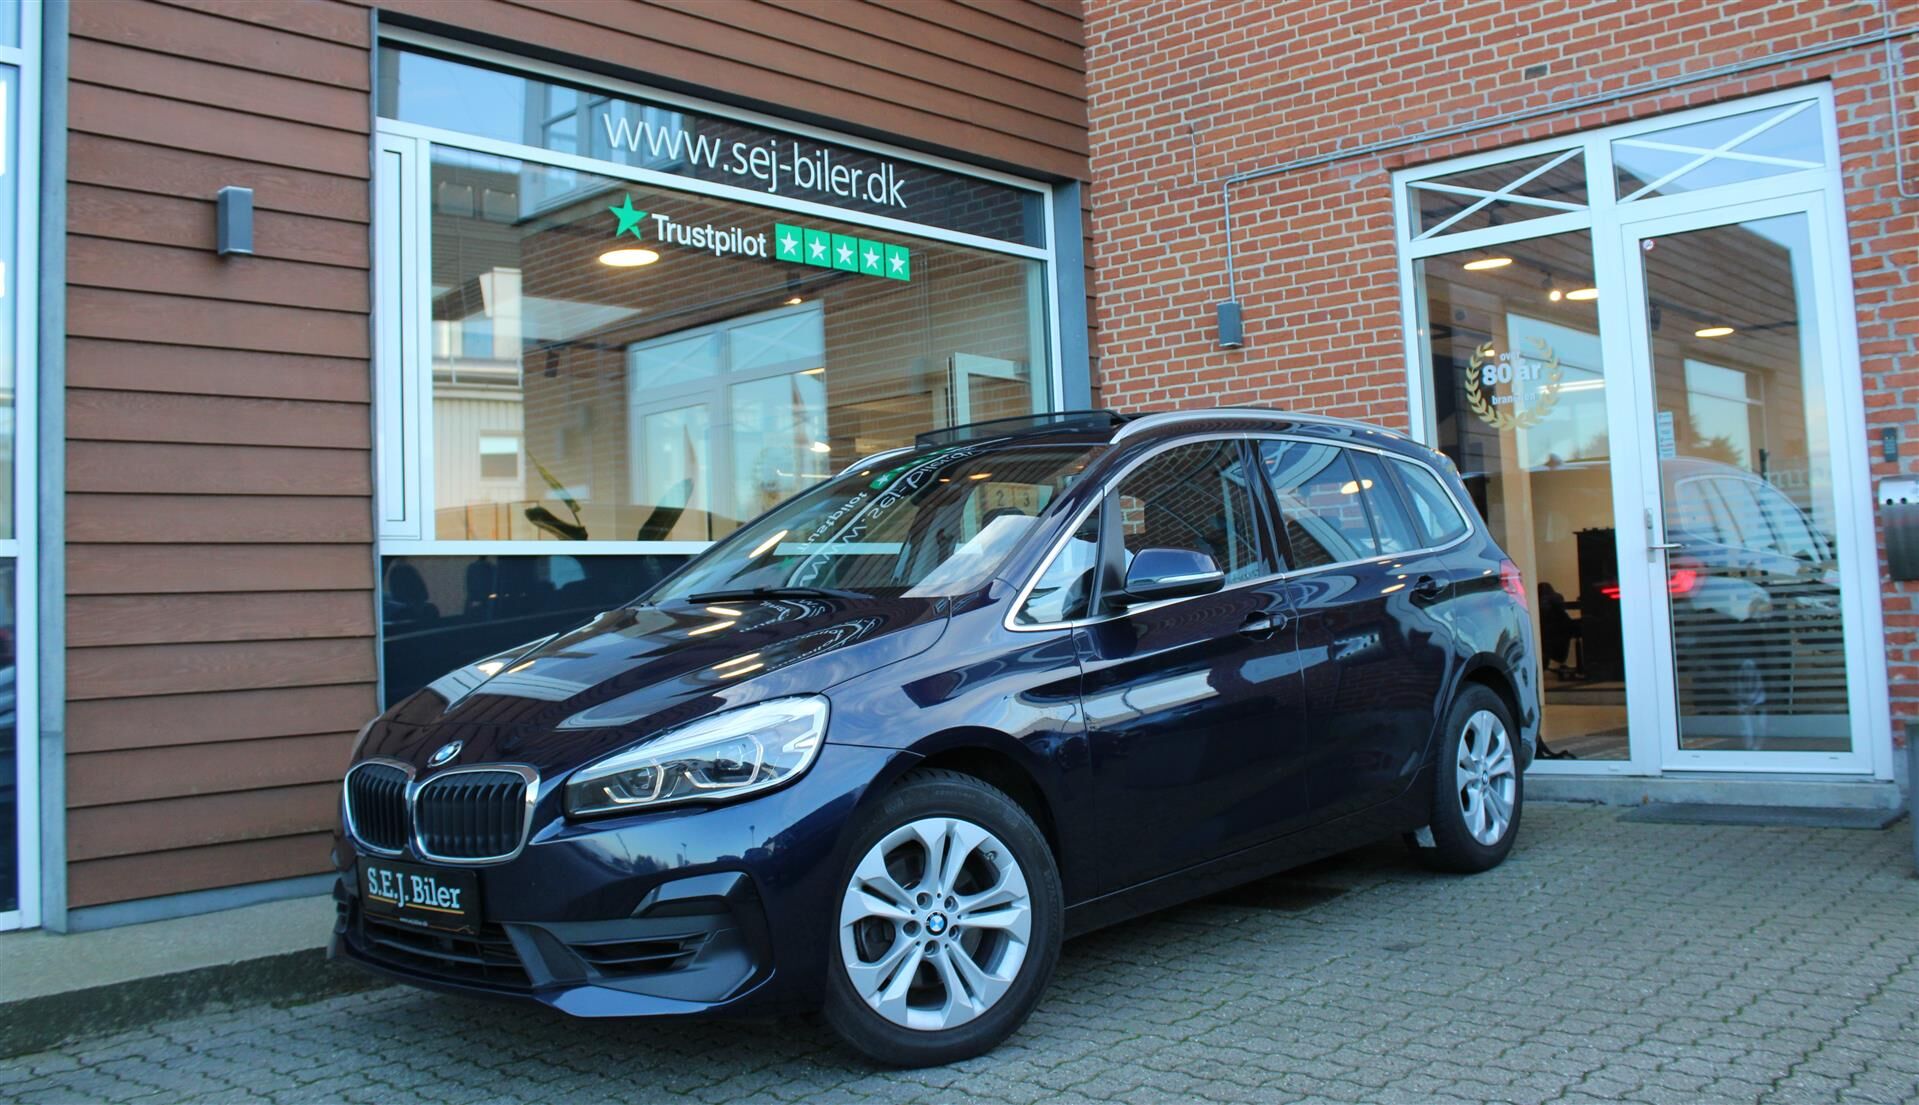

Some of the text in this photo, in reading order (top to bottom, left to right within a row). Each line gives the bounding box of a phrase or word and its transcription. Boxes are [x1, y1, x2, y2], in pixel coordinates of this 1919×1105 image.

[603, 113, 908, 208] www.sej-biler.dk
[651, 213, 768, 258] Trustpilot
[1482, 363, 1512, 385] 80
[367, 866, 461, 909] S.E.J. Biler
